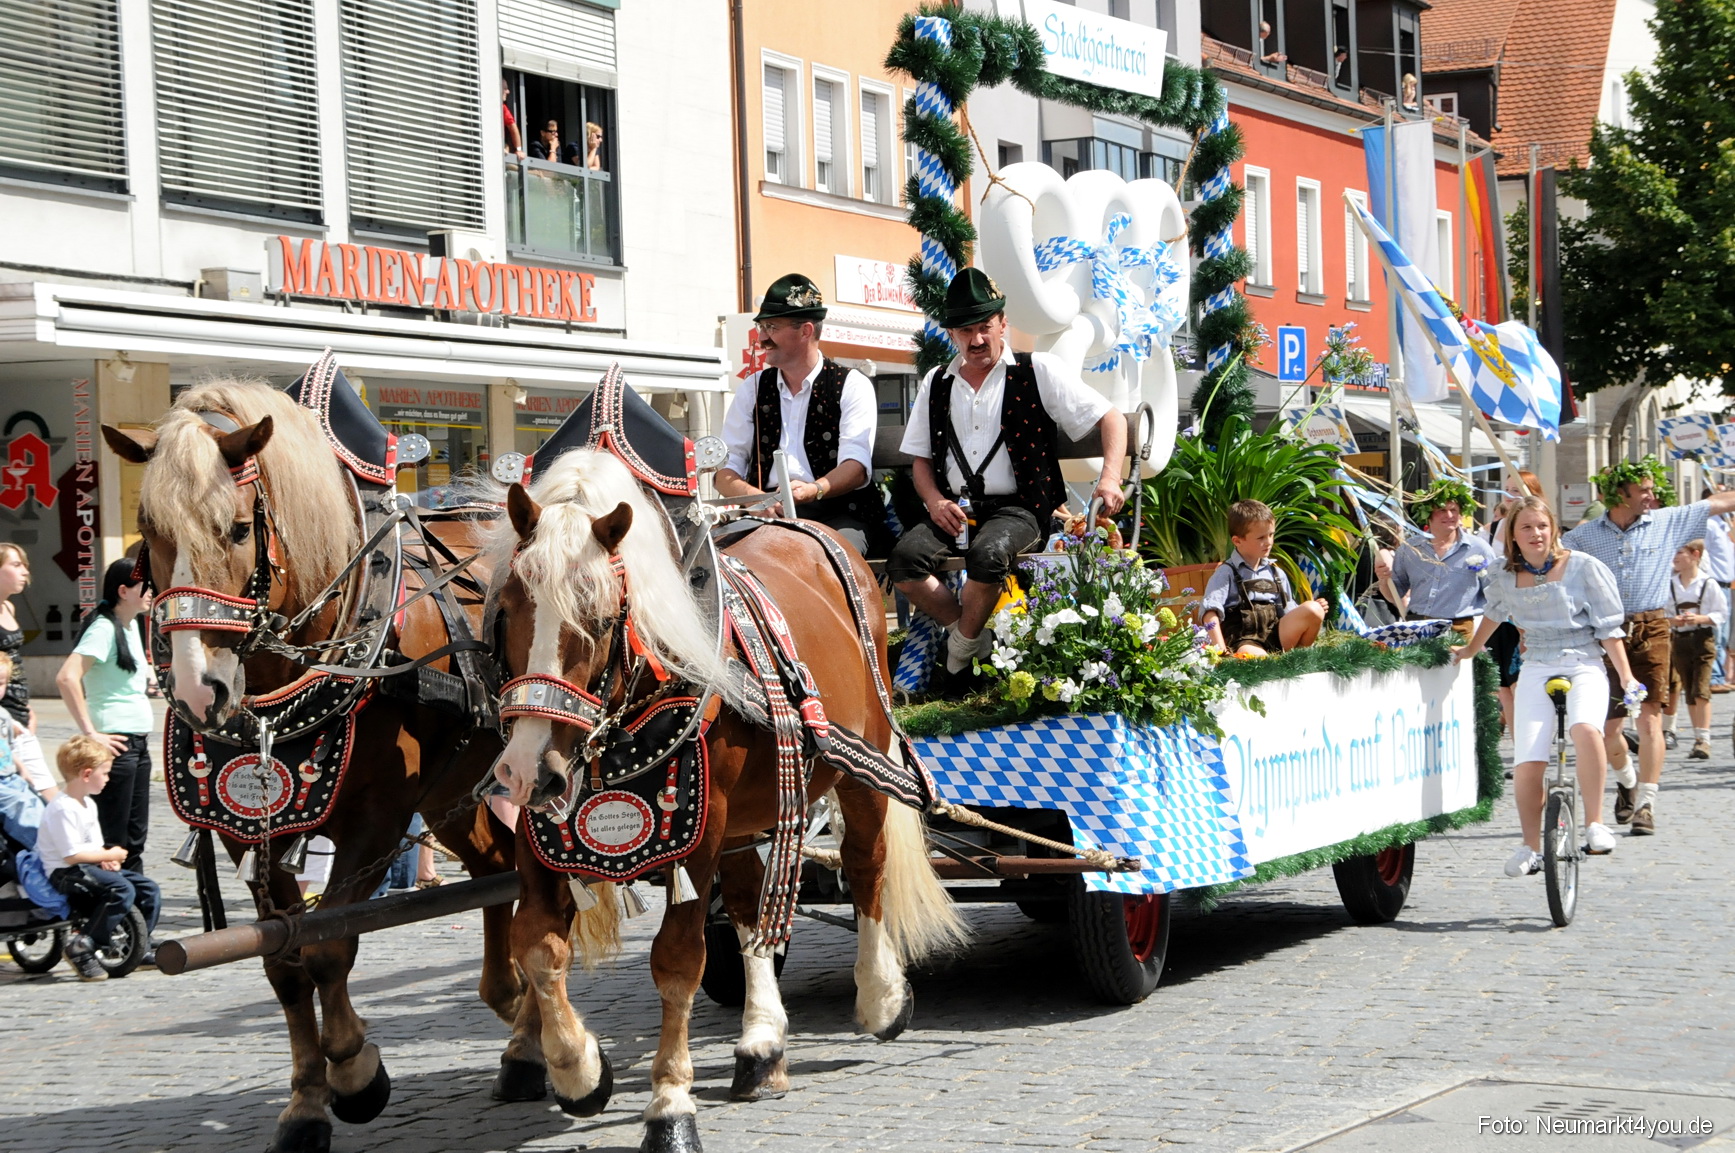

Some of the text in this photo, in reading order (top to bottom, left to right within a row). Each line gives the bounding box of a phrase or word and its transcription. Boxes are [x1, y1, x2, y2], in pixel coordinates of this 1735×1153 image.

[1042, 13, 1147, 77] Stadtgärtnerei
[277, 235, 598, 323] MARIEN-APOTHEKE
[864, 284, 876, 304] DER
[1284, 333, 1300, 375] P
[379, 388, 481, 409] MARIEN APOTHEKE
[72, 378, 97, 624] MARIEN APOTHEK
[1222, 698, 1461, 838] Olympiade auf Bairisch
[587, 811, 641, 822] An Gottes Segen
[617, 823, 640, 832] gelegen
